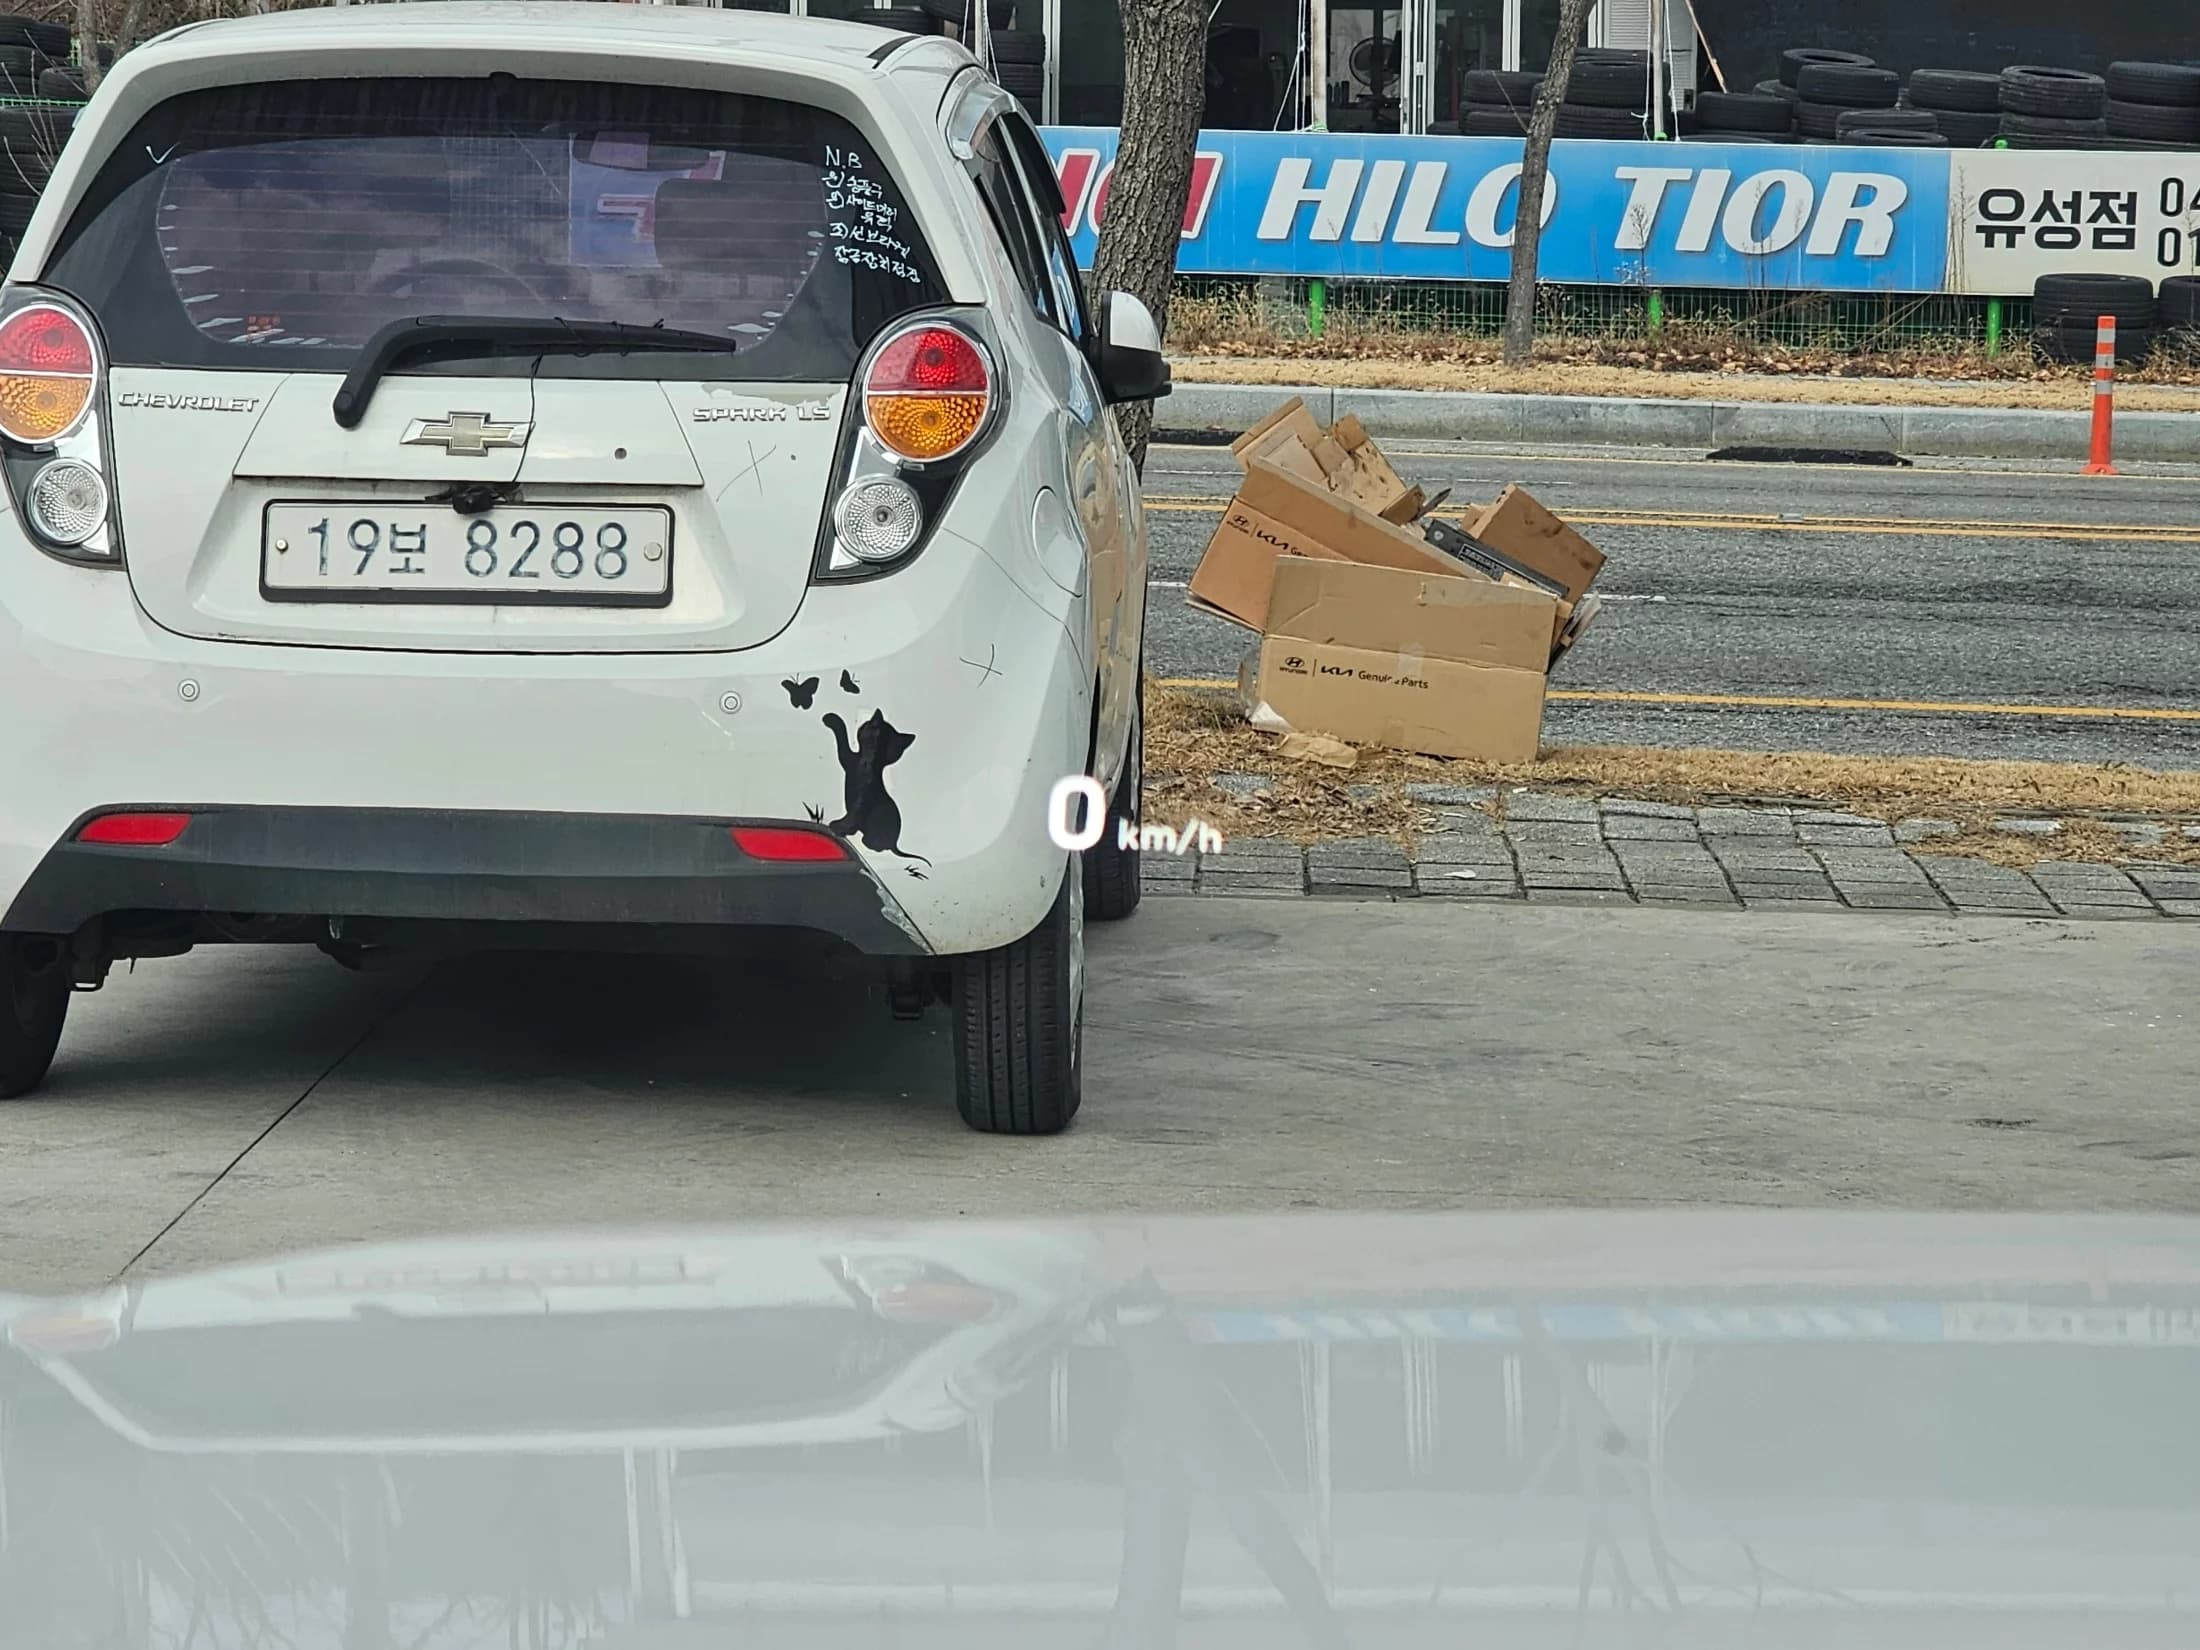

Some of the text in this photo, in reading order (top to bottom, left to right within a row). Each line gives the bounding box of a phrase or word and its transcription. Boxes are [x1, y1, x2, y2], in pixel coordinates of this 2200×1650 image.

[825, 144, 863, 169] N.B
[1614, 166, 1908, 256] TIOR
[1975, 188, 2138, 250] 유성점
[118, 392, 260, 412] CHEVROLET
[693, 406, 831, 422] SPARK LS
[307, 517, 628, 580] 19보 8288
[1401, 676, 1430, 689] Parts
